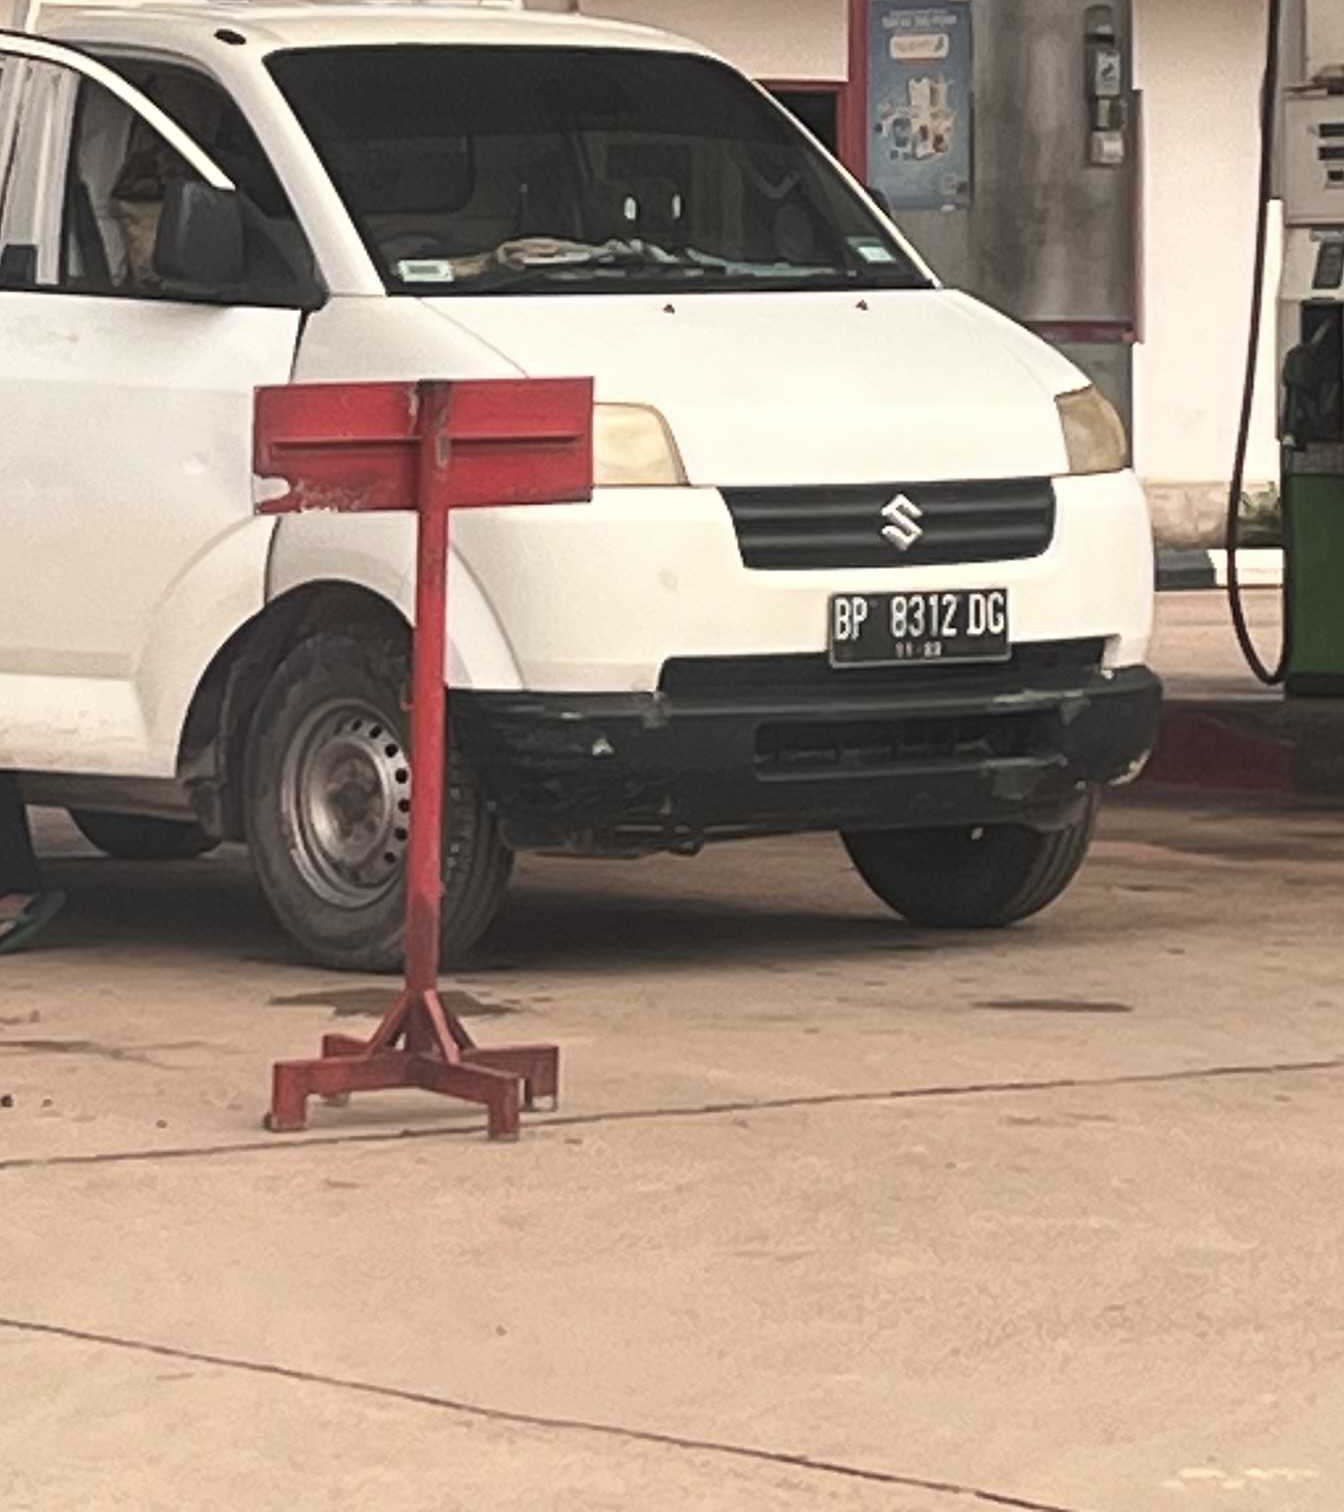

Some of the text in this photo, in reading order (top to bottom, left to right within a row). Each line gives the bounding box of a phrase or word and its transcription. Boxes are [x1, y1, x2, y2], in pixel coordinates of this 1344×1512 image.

[834, 591, 1004, 640] BP 8312 DG
